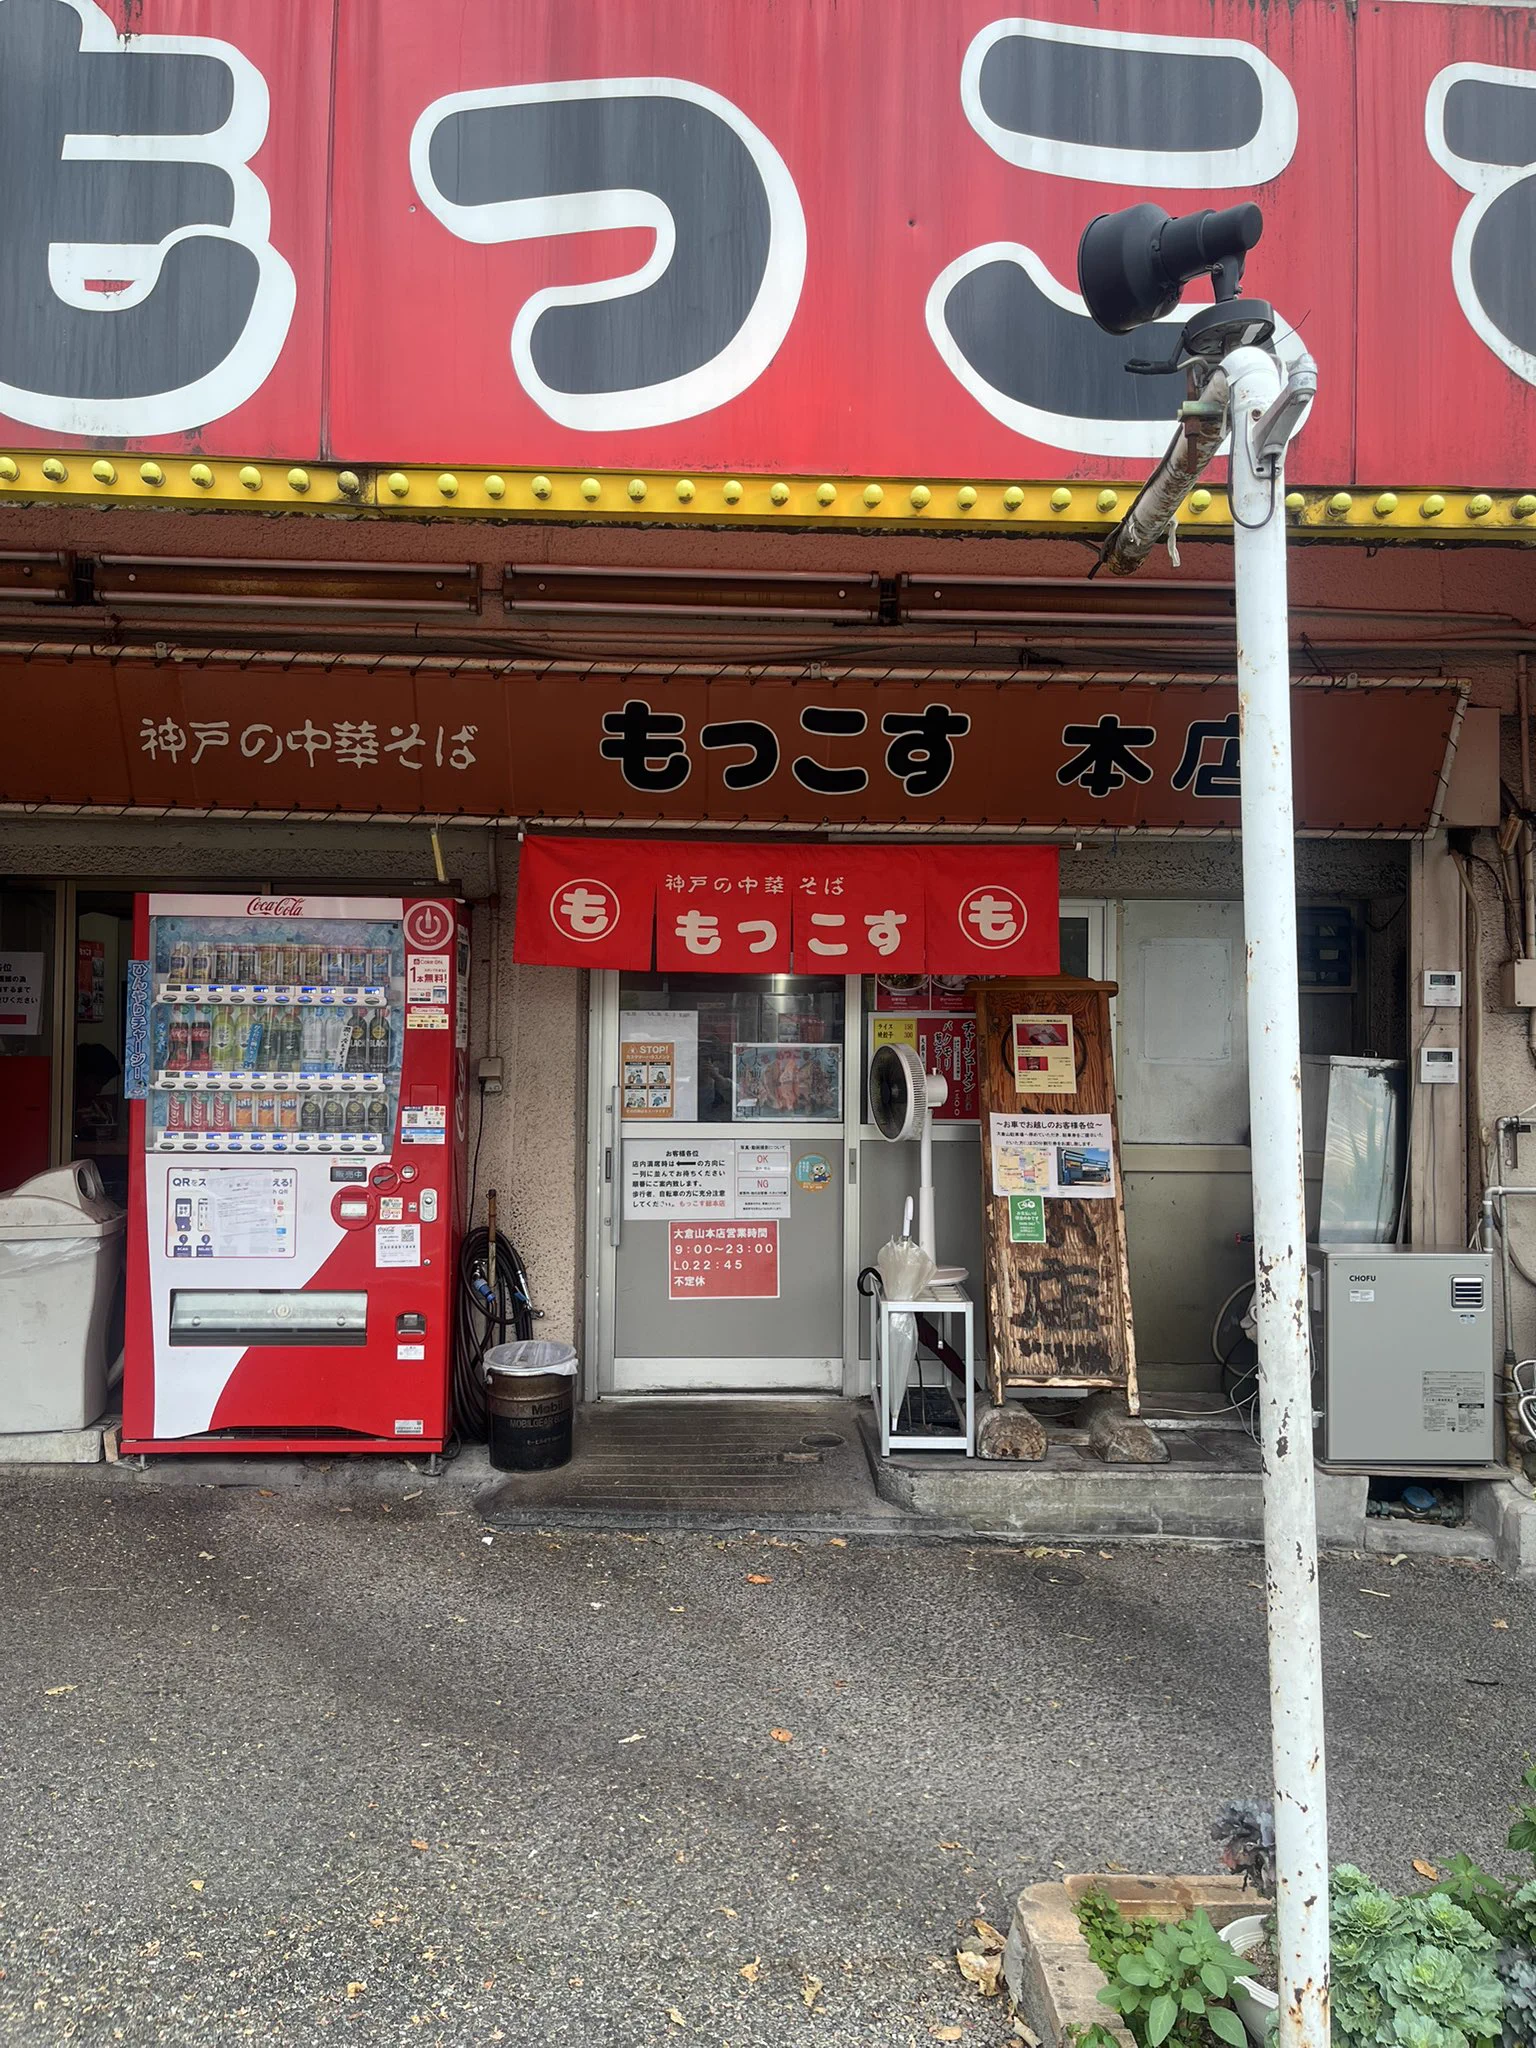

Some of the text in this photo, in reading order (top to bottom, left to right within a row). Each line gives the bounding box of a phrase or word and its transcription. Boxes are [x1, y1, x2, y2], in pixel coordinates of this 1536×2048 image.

[0, 0, 1536, 459] もっこ
[140, 716, 479, 771] 神戸の中華そば
[599, 699, 972, 798] もっこす
[664, 873, 845, 896] 神戸の中華そば
[246, 896, 305, 917] Coca-Cola
[560, 887, 609, 935] も
[967, 894, 1018, 941] も
[674, 908, 908, 957] もっこす
[639, 1045, 669, 1054] STOP!
[962, 1020, 976, 1093] チャーシューメン
[665, 1150, 699, 1158] お客様各位
[756, 1154, 769, 1164] OK
[757, 1179, 769, 1189] NG
[673, 1227, 768, 1239] 大倉山本店営業時間
[673, 1275, 706, 1287] 不定休
[531, 1399, 565, 1416] Mobil
